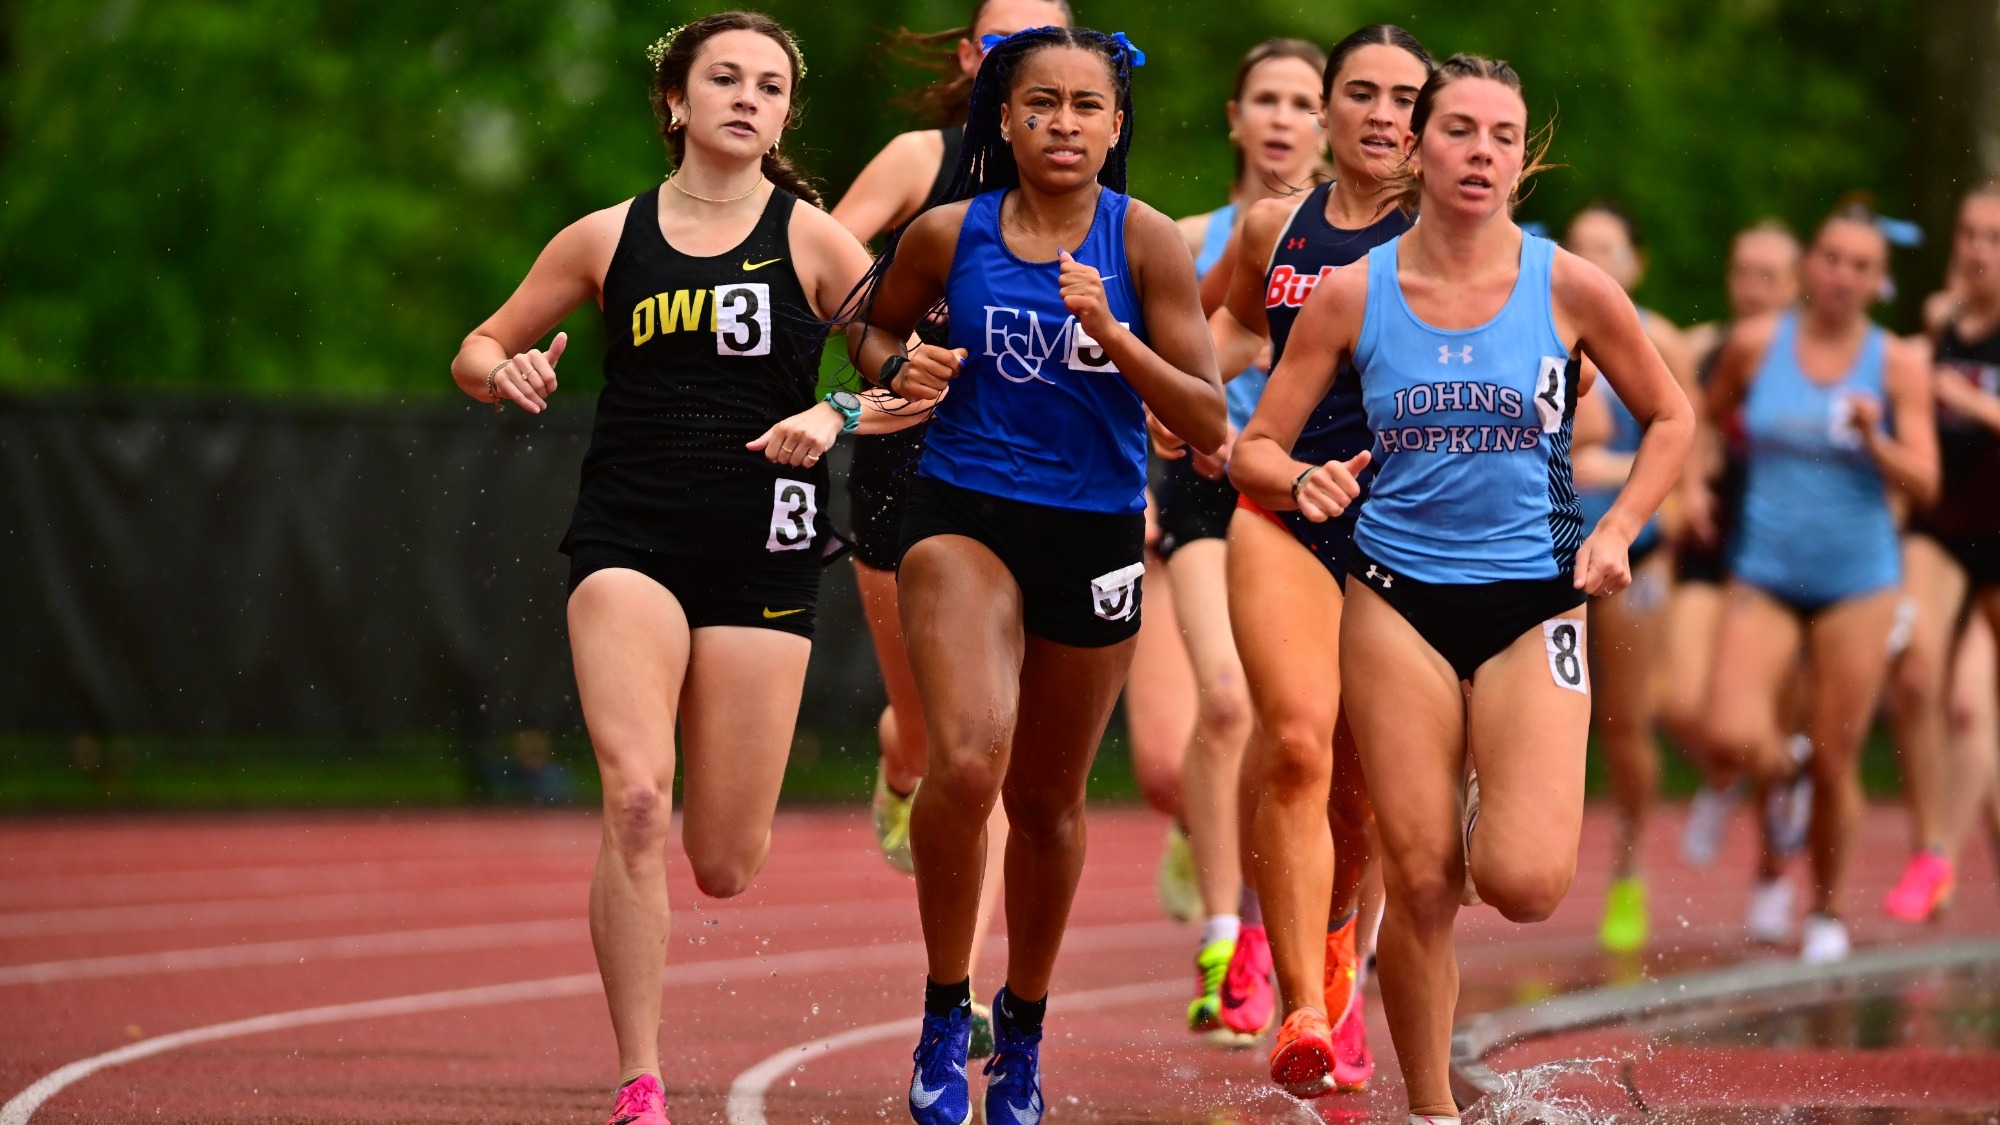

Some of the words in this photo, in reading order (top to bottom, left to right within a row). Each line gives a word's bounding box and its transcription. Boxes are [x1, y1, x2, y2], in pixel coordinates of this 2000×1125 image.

[722, 287, 762, 352] 3
[982, 305, 1077, 385] F&M
[1394, 381, 1523, 421] JOHNS
[1378, 425, 1544, 454] HOPKINS
[774, 484, 808, 546] 3
[1551, 624, 1581, 686] 8
